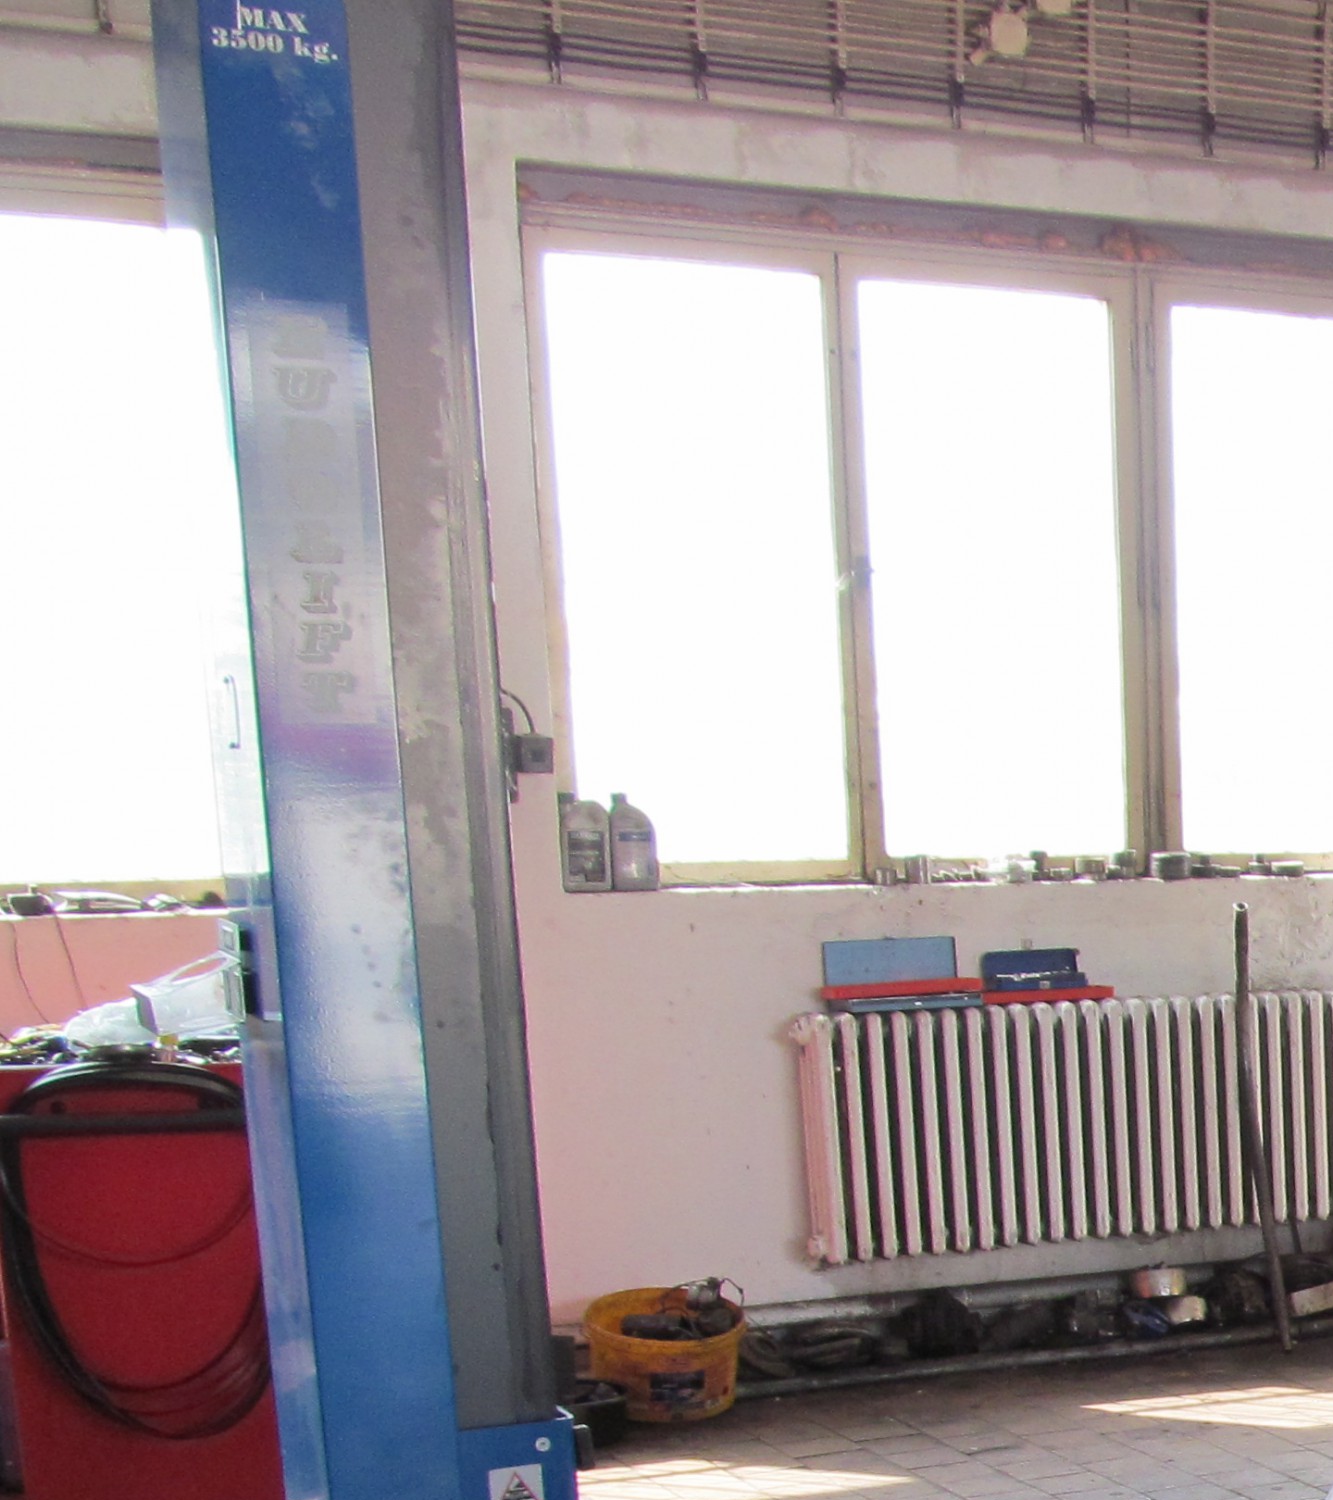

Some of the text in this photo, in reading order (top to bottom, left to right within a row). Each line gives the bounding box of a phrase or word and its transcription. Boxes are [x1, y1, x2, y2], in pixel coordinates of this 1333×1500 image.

[240, 7, 309, 34] MAX
[211, 26, 339, 64] 3500 kg.
